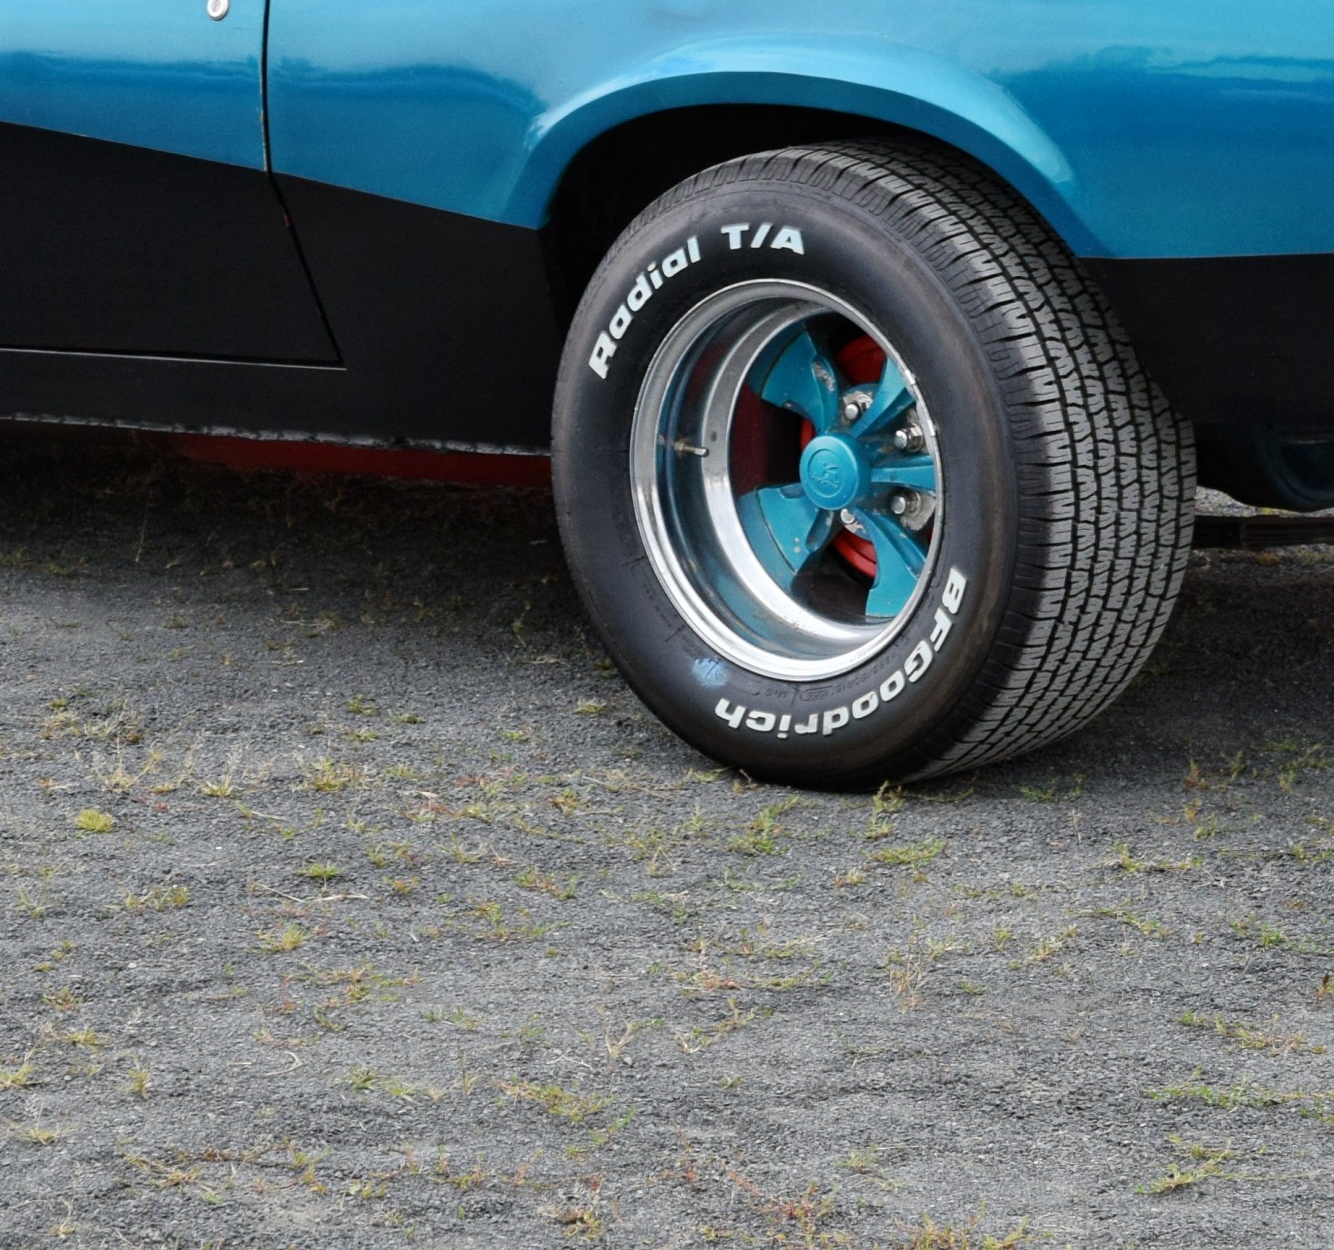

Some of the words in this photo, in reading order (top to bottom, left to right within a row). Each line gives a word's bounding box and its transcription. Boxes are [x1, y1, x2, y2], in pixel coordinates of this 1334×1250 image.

[587, 235, 702, 380] Radial
[720, 222, 805, 255] T/A
[713, 566, 968, 740] BFGoodrich
